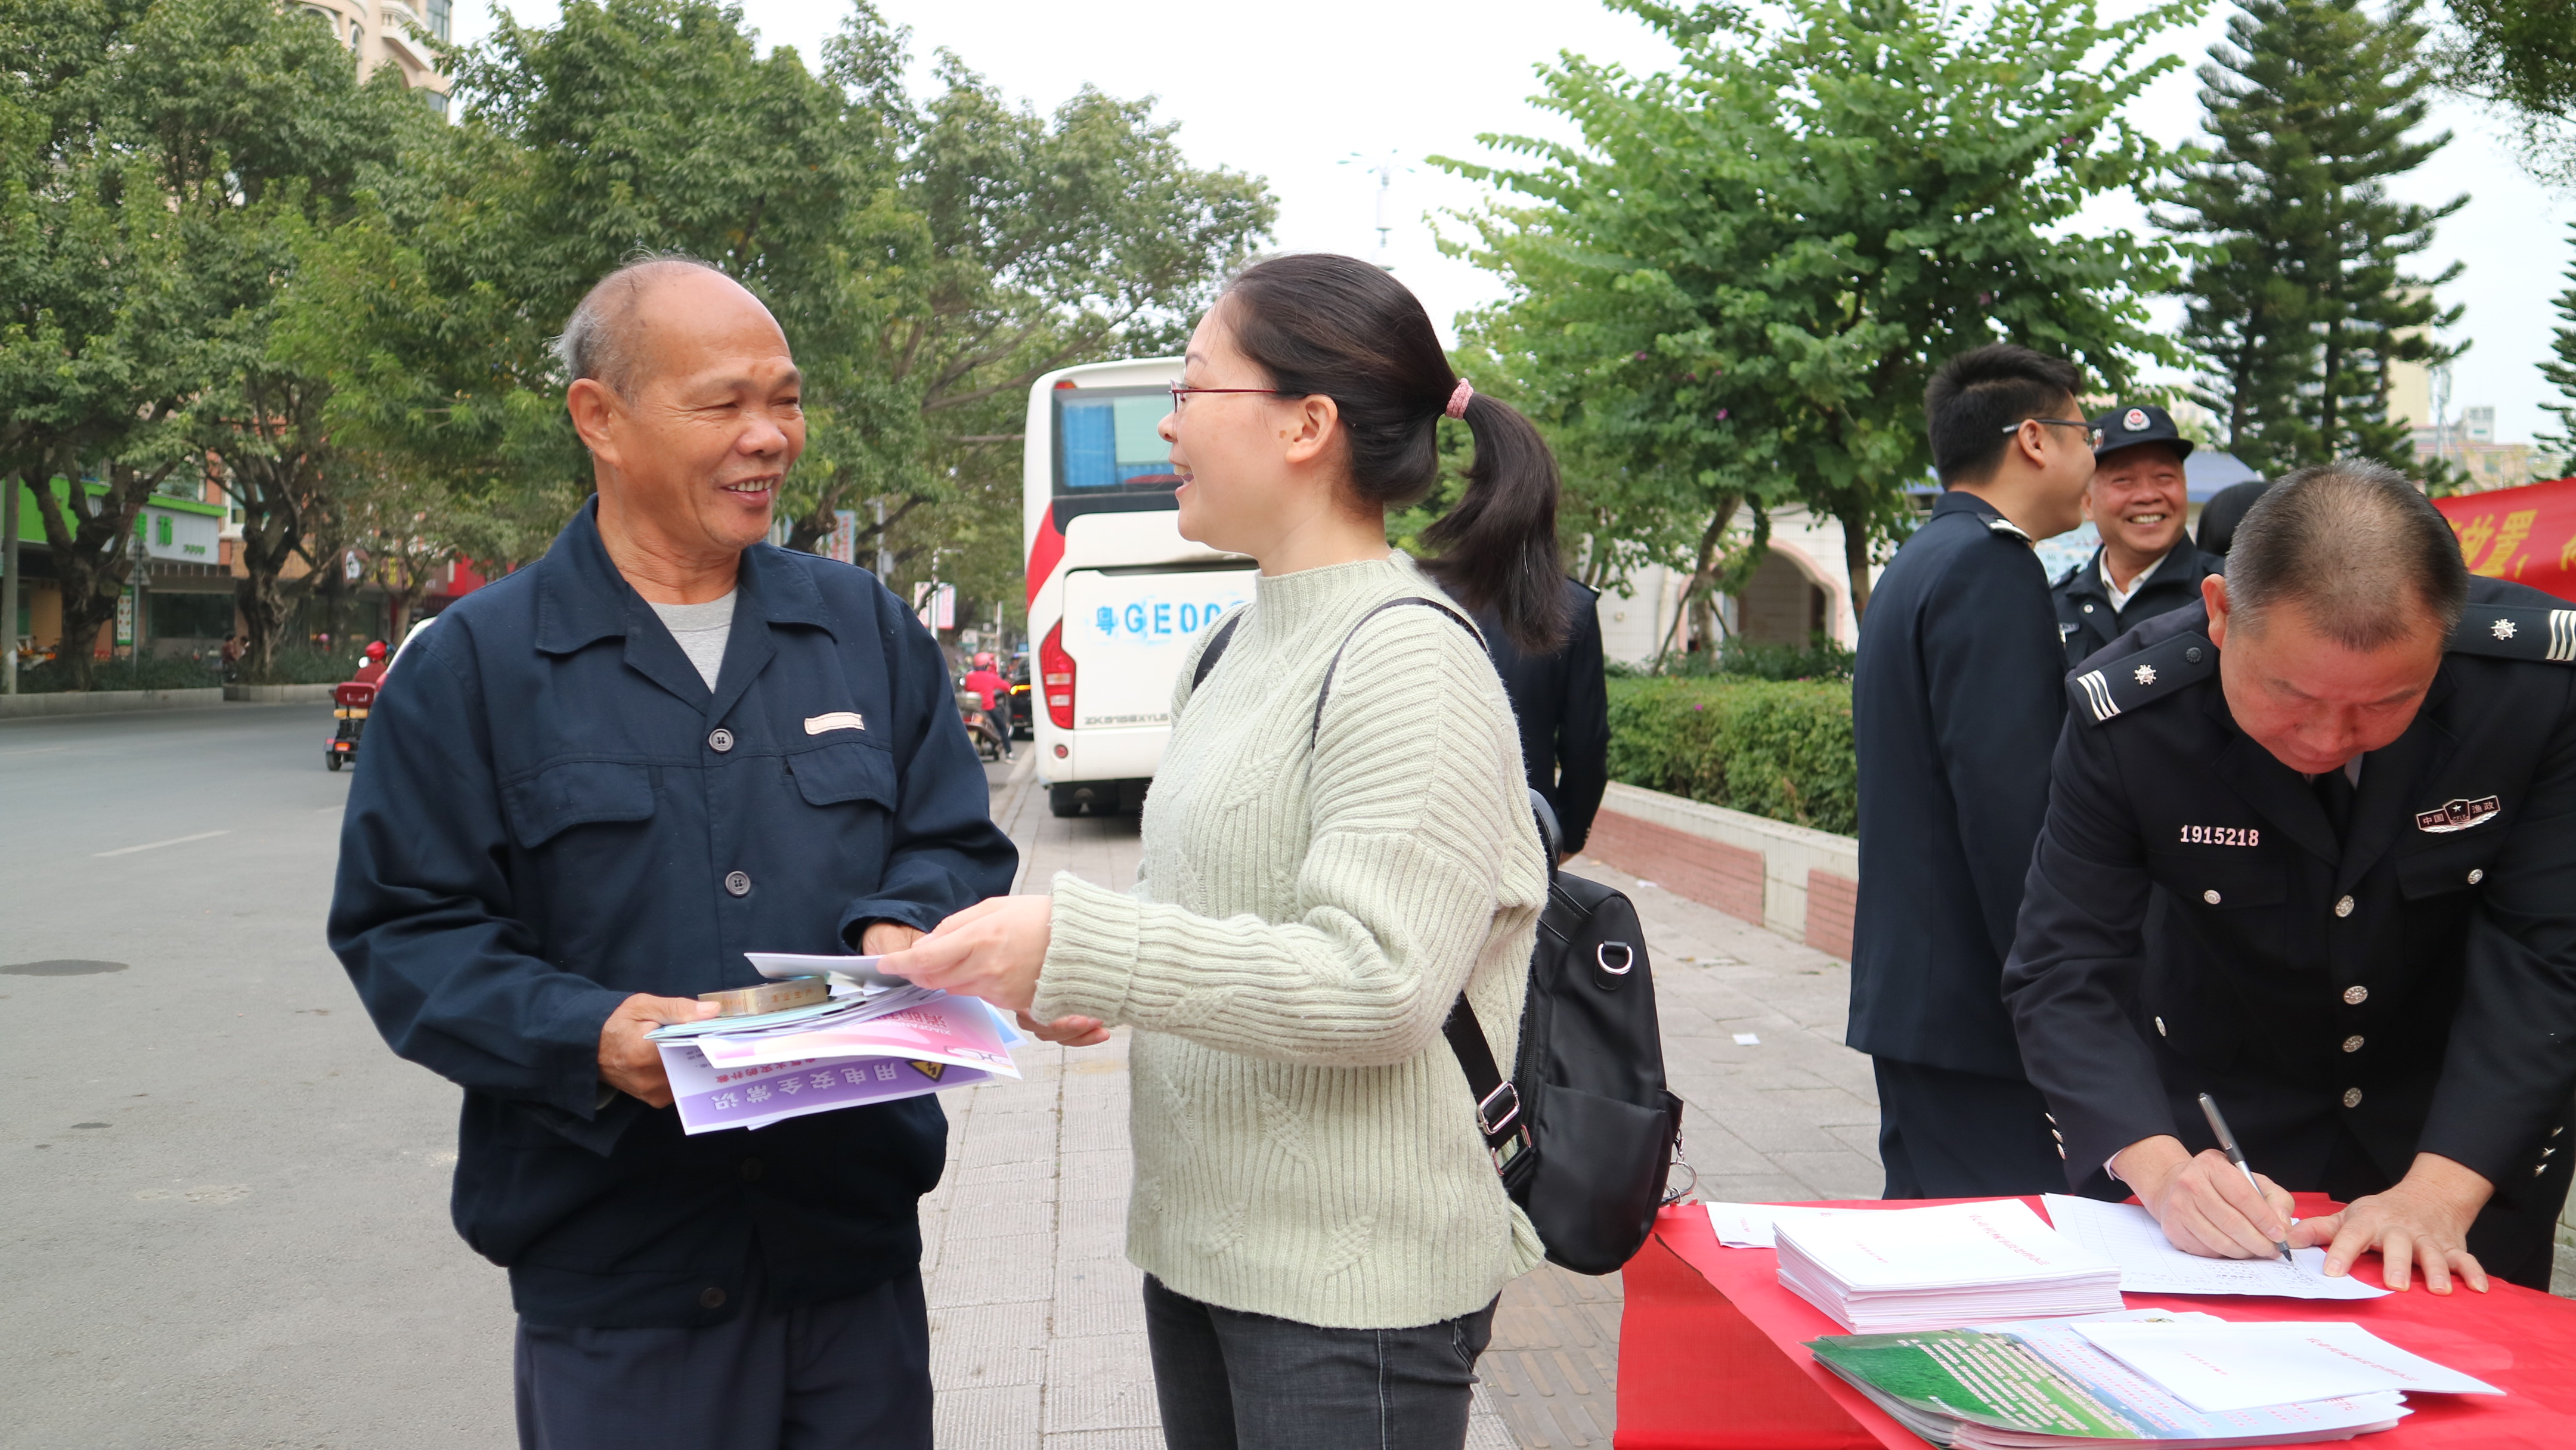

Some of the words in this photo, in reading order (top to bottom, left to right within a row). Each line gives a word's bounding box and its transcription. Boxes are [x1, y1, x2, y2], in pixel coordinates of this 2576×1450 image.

[1095, 600, 1245, 636] 粤GE00
[2423, 814, 2445, 825] 中国
[2472, 801, 2495, 814] 渔政
[2181, 825, 2259, 847] 1915218
[710, 1063, 897, 1111] 用电安全常识
